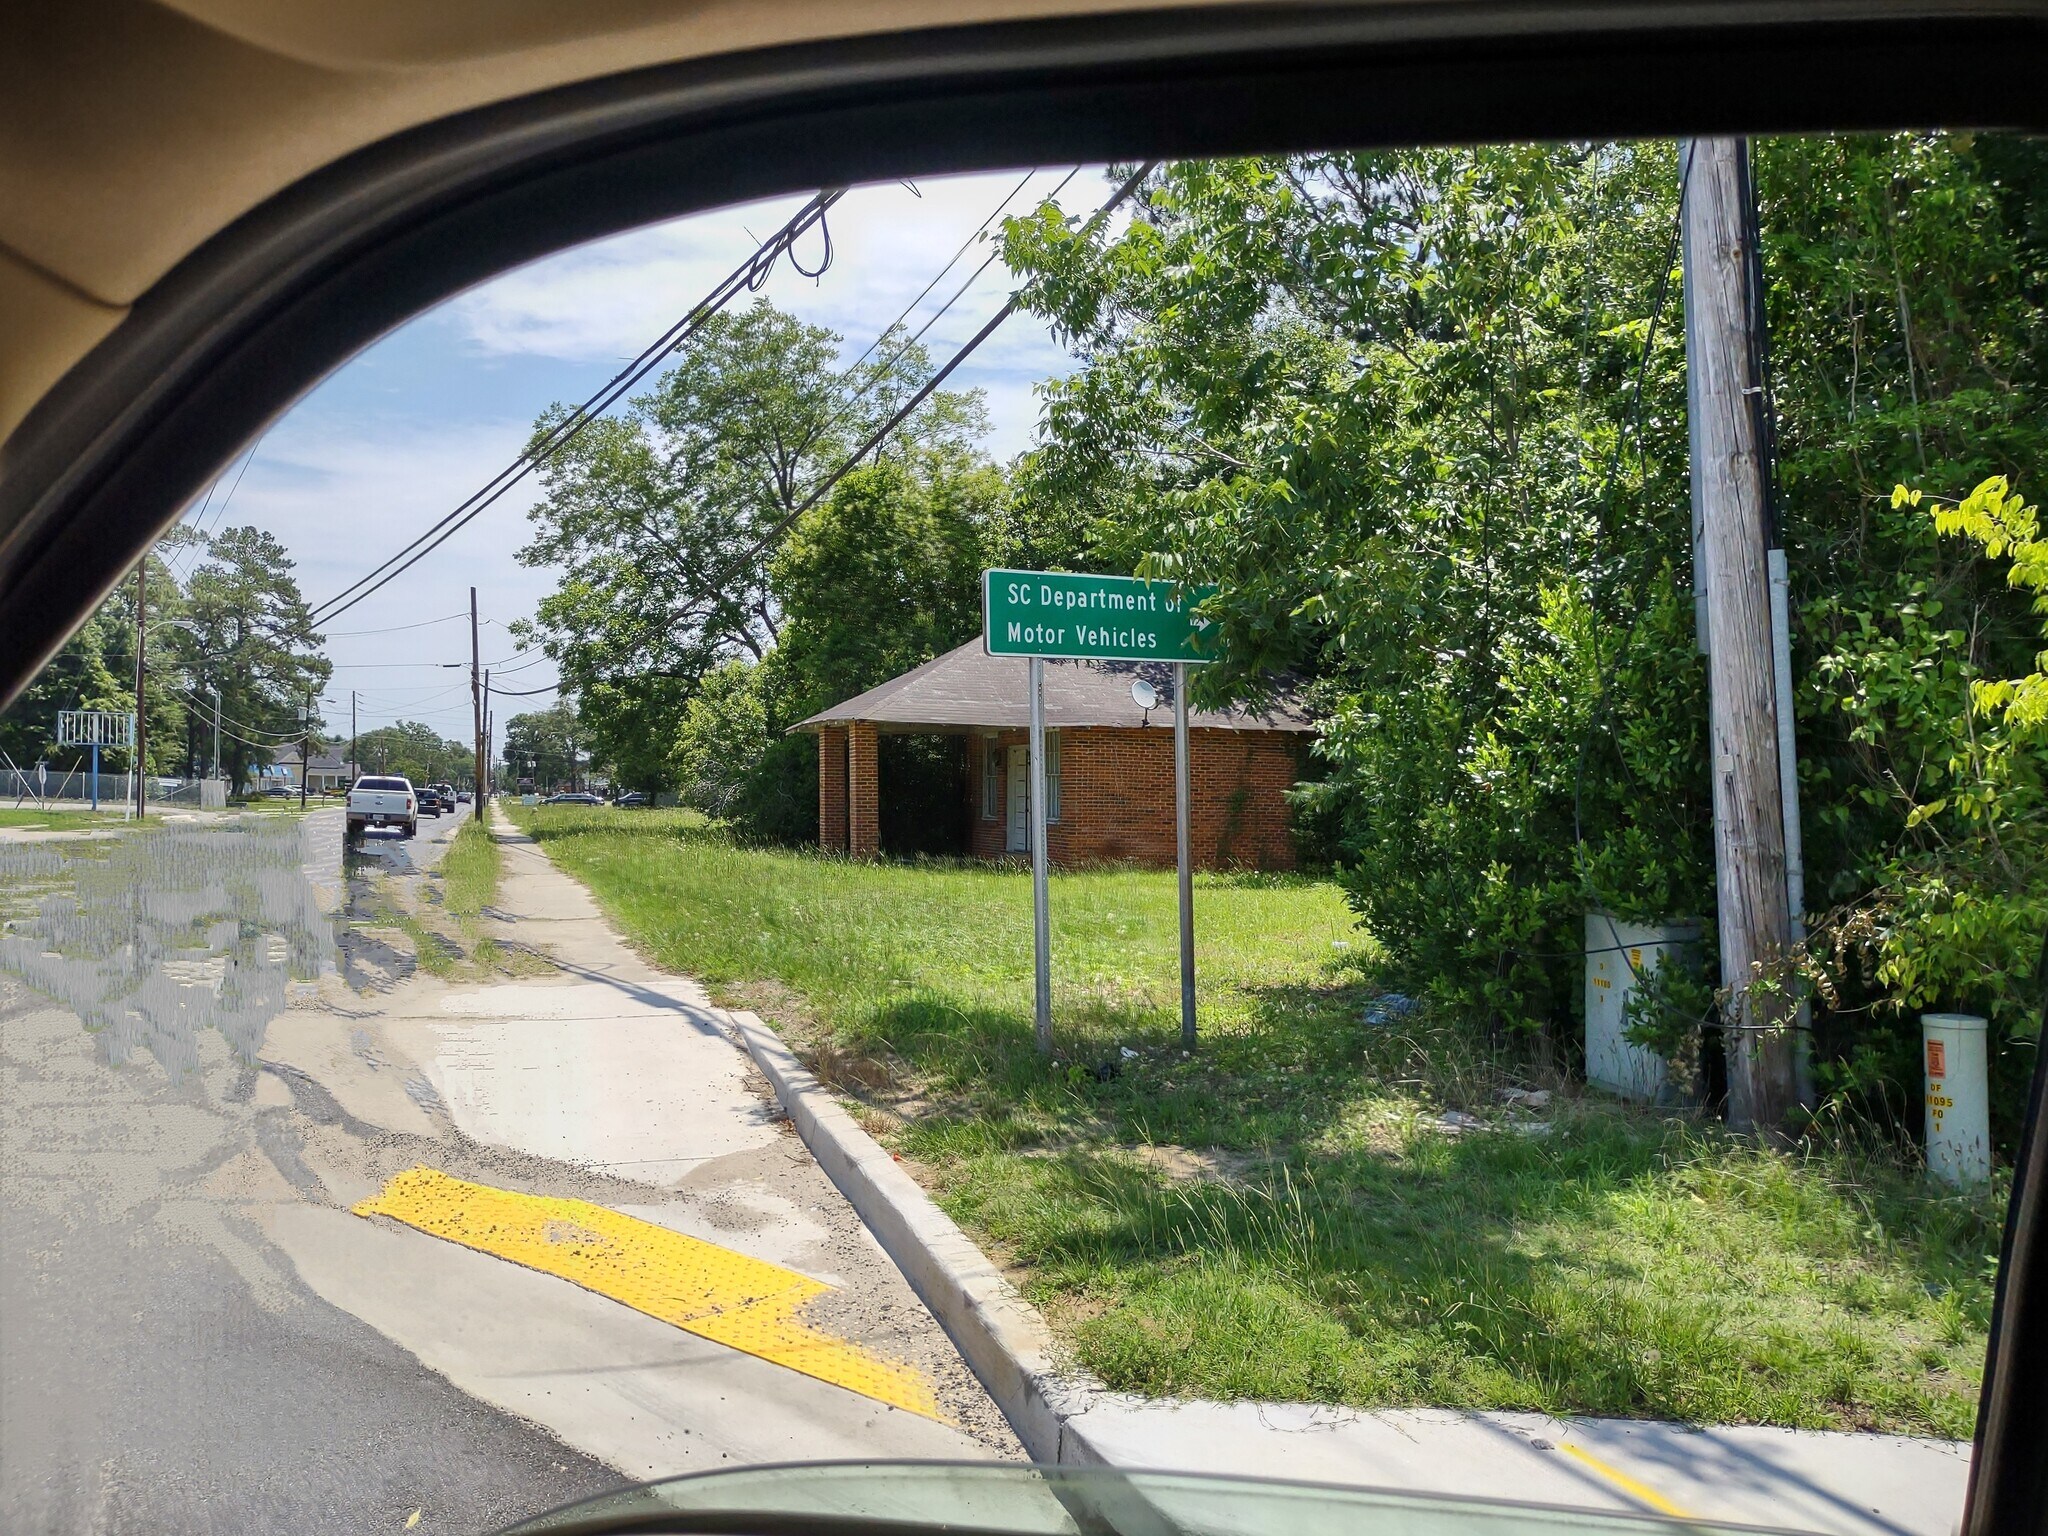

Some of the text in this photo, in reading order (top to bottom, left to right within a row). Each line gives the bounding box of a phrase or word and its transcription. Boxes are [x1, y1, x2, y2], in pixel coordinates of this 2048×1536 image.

[1008, 583, 1031, 605] SC
[1041, 584, 1156, 612] Department
[1008, 621, 1157, 649] Motor Vehicles
